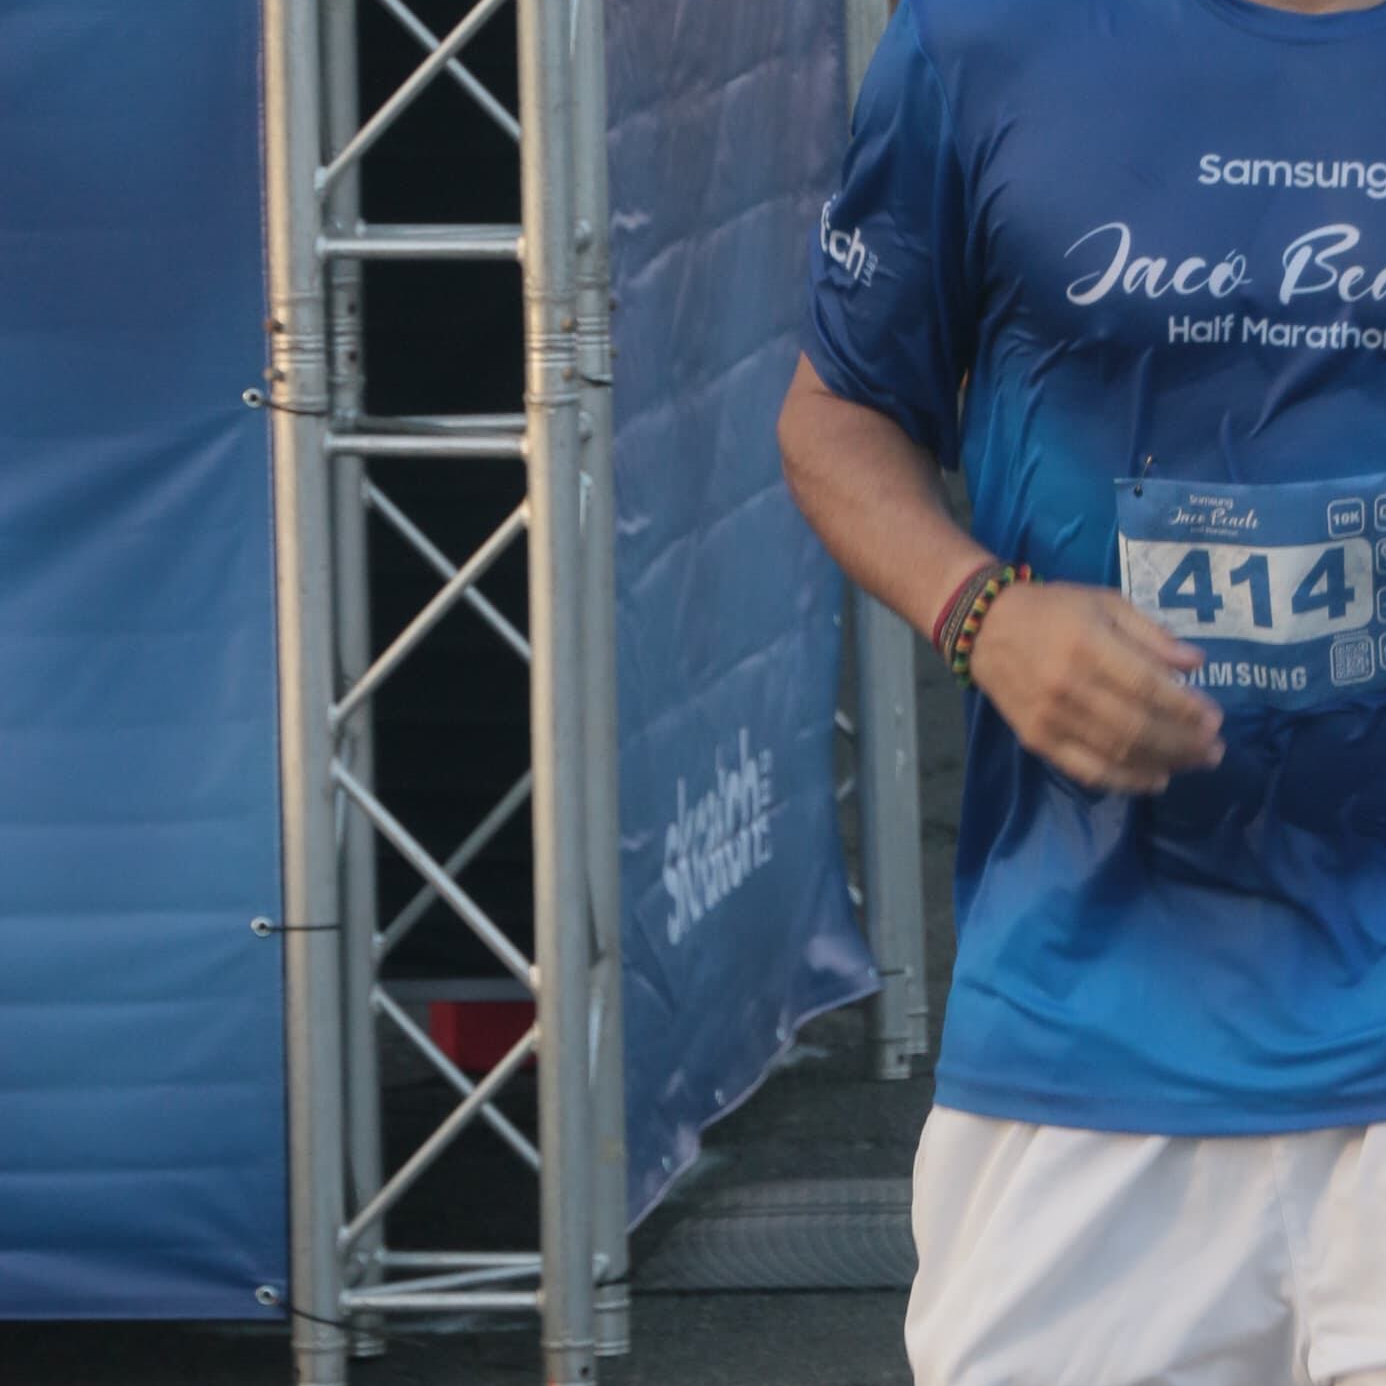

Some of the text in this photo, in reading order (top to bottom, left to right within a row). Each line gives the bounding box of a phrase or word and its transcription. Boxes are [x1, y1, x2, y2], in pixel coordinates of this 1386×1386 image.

[1168, 315, 1234, 344] Half
[1333, 510, 1360, 526] 10K
[1158, 547, 1354, 629] 414
